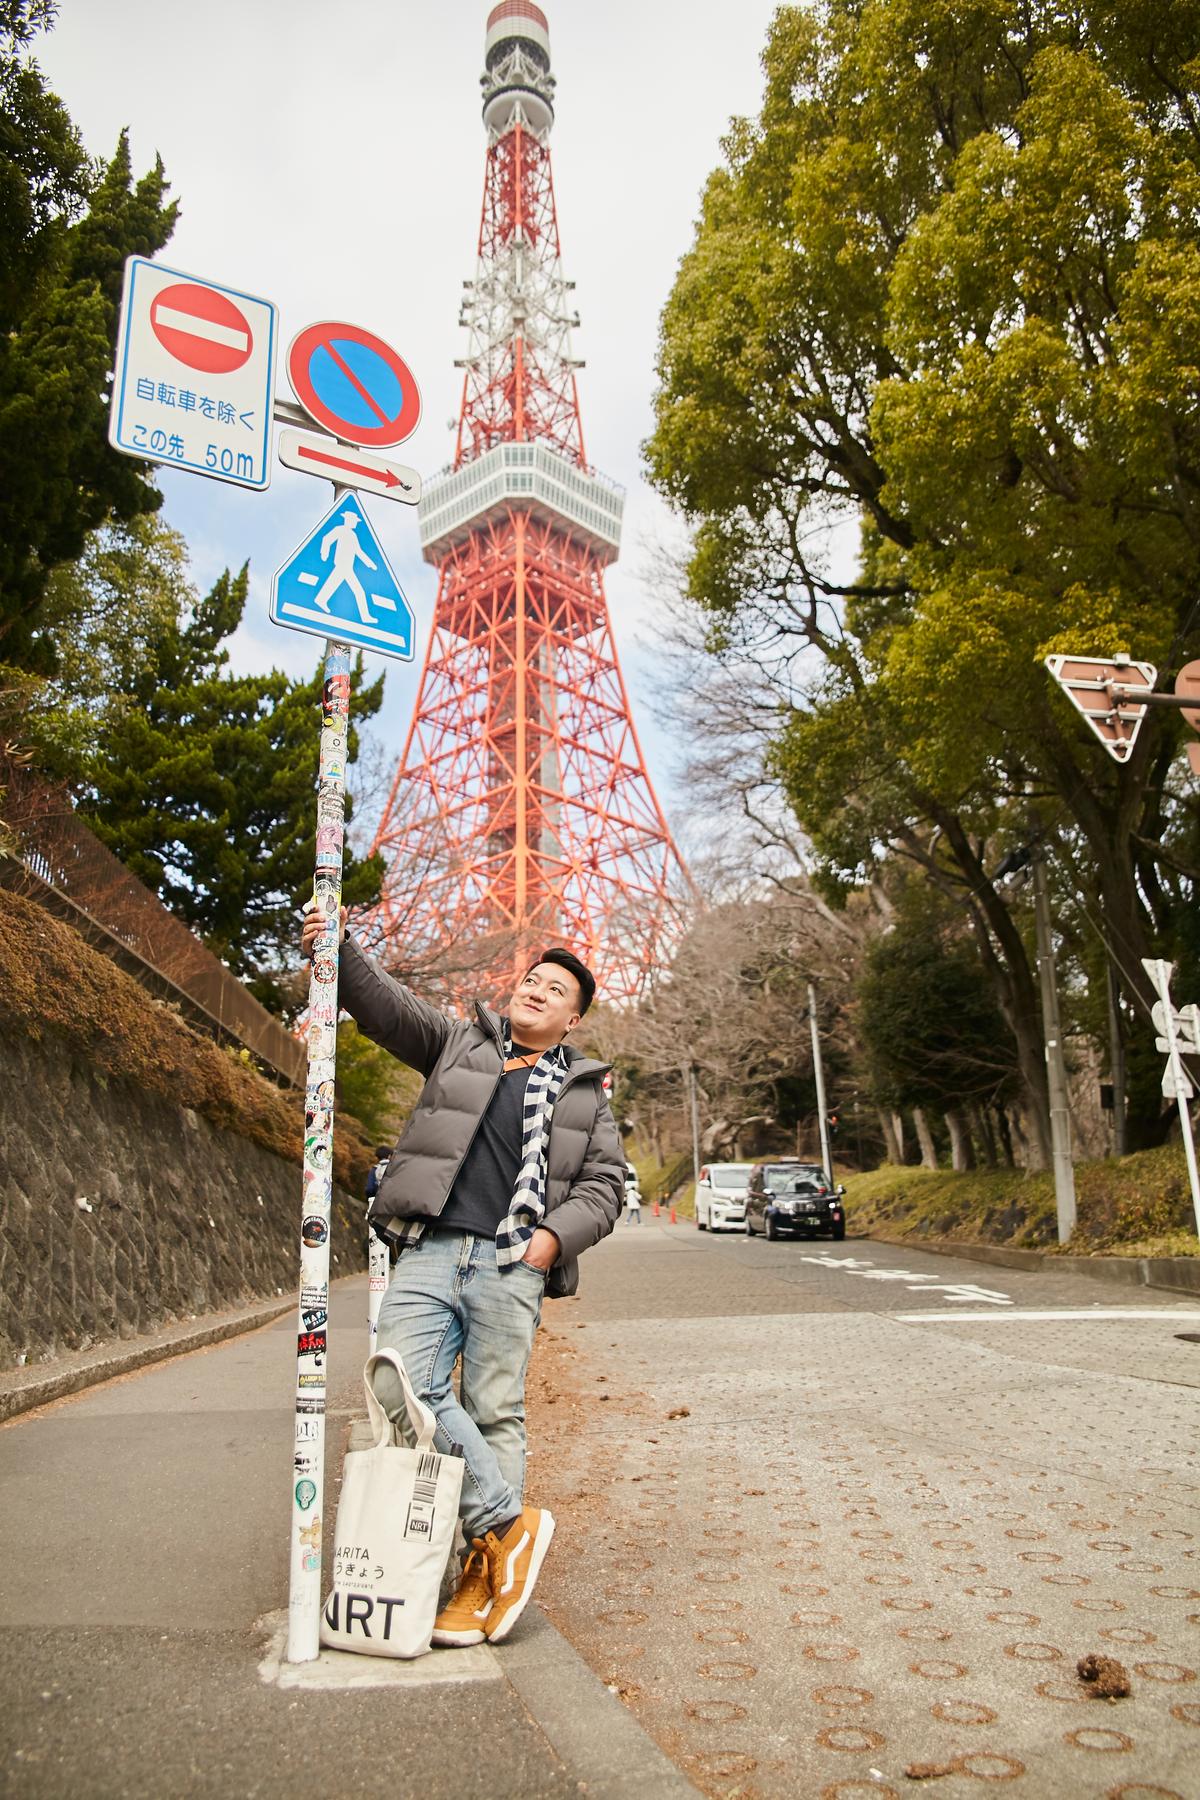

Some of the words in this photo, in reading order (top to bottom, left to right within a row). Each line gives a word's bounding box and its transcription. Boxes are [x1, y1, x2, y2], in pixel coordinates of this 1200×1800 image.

[136, 377, 255, 431] 自転車を除く
[133, 423, 185, 458] この先
[205, 444, 254, 478] 50m
[411, 1520, 428, 1532] NRT
[333, 1547, 370, 1561] ARITA
[325, 1591, 405, 1640] NRT
